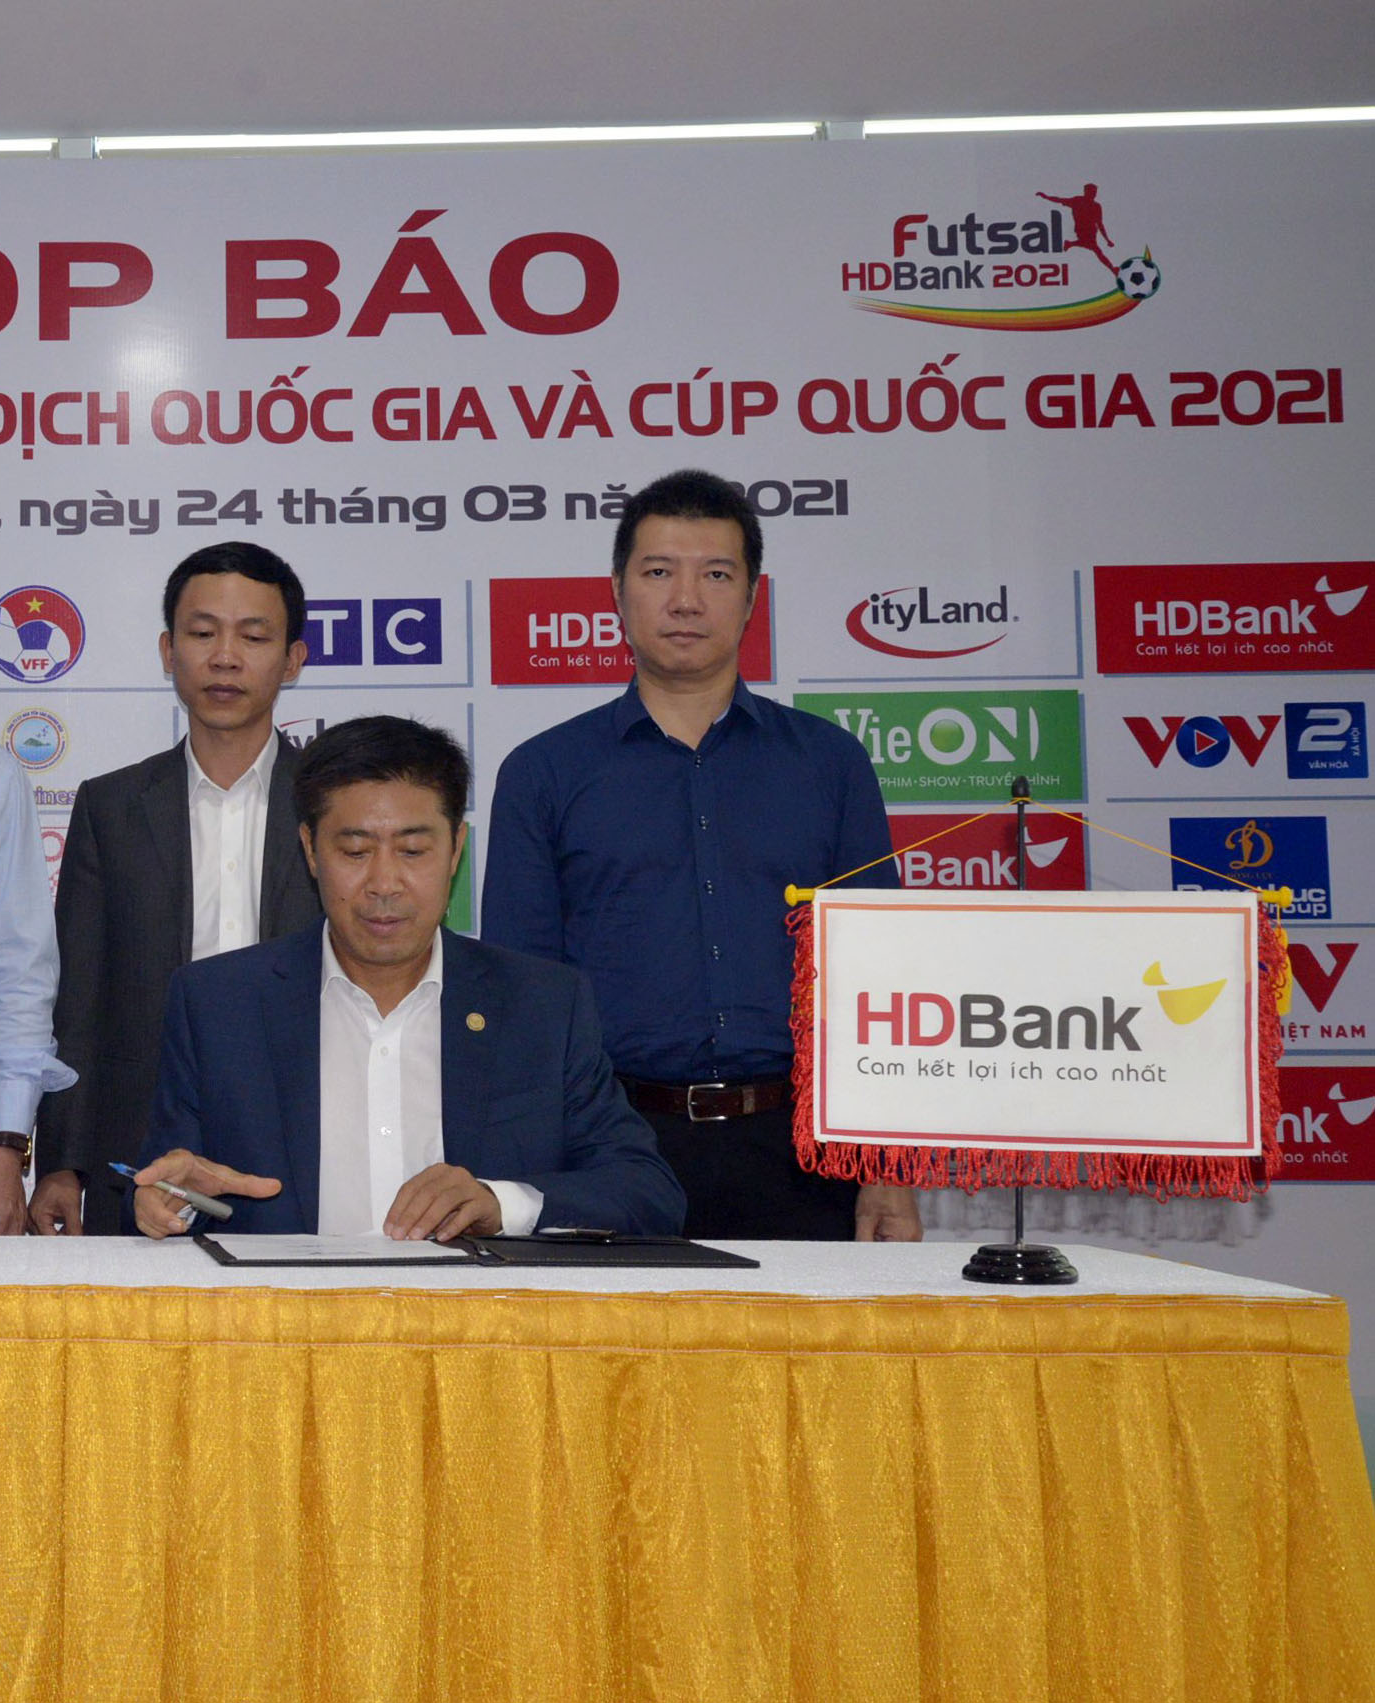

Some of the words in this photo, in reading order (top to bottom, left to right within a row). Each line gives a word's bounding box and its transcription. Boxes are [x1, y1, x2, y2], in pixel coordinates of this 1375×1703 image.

[892, 210, 1064, 258] Futsal
[225, 209, 620, 340] BÁO
[841, 259, 985, 291] HDBank
[992, 263, 1069, 288] 2021
[150, 366, 354, 446] QUỐC
[371, 387, 498, 442] GIA
[508, 370, 615, 439] VÀ
[628, 368, 779, 438] CÚP
[797, 353, 1007, 435] QUỐC
[1025, 373, 1156, 429] GIA
[1169, 368, 1345, 427] 2021
[20, 490, 160, 535] ngày
[177, 489, 263, 527] 24
[277, 487, 447, 532] tháng
[463, 485, 548, 521] 03
[564, 484, 625, 520] nă
[728, 479, 849, 517] 021
[528, 612, 625, 648] HDB
[1135, 599, 1317, 637] HDBank
[21, 659, 49, 671] VFF
[529, 654, 560, 667] Cam
[1136, 643, 1168, 656] Cam
[1263, 643, 1291, 654] cao
[1122, 715, 1282, 768] VOV
[1297, 708, 1352, 752] 2
[919, 774, 961, 787] SHOW
[894, 850, 1018, 886] Bank
[857, 991, 1141, 1051] HDBank
[1321, 1025, 1366, 1038] NAM
[857, 1056, 904, 1076] Cam
[918, 1058, 955, 1078] kết
[969, 1060, 997, 1082] lợi
[1010, 1061, 1042, 1080] ích
[1056, 1066, 1098, 1081] cao
[1112, 1063, 1167, 1082] nhất
